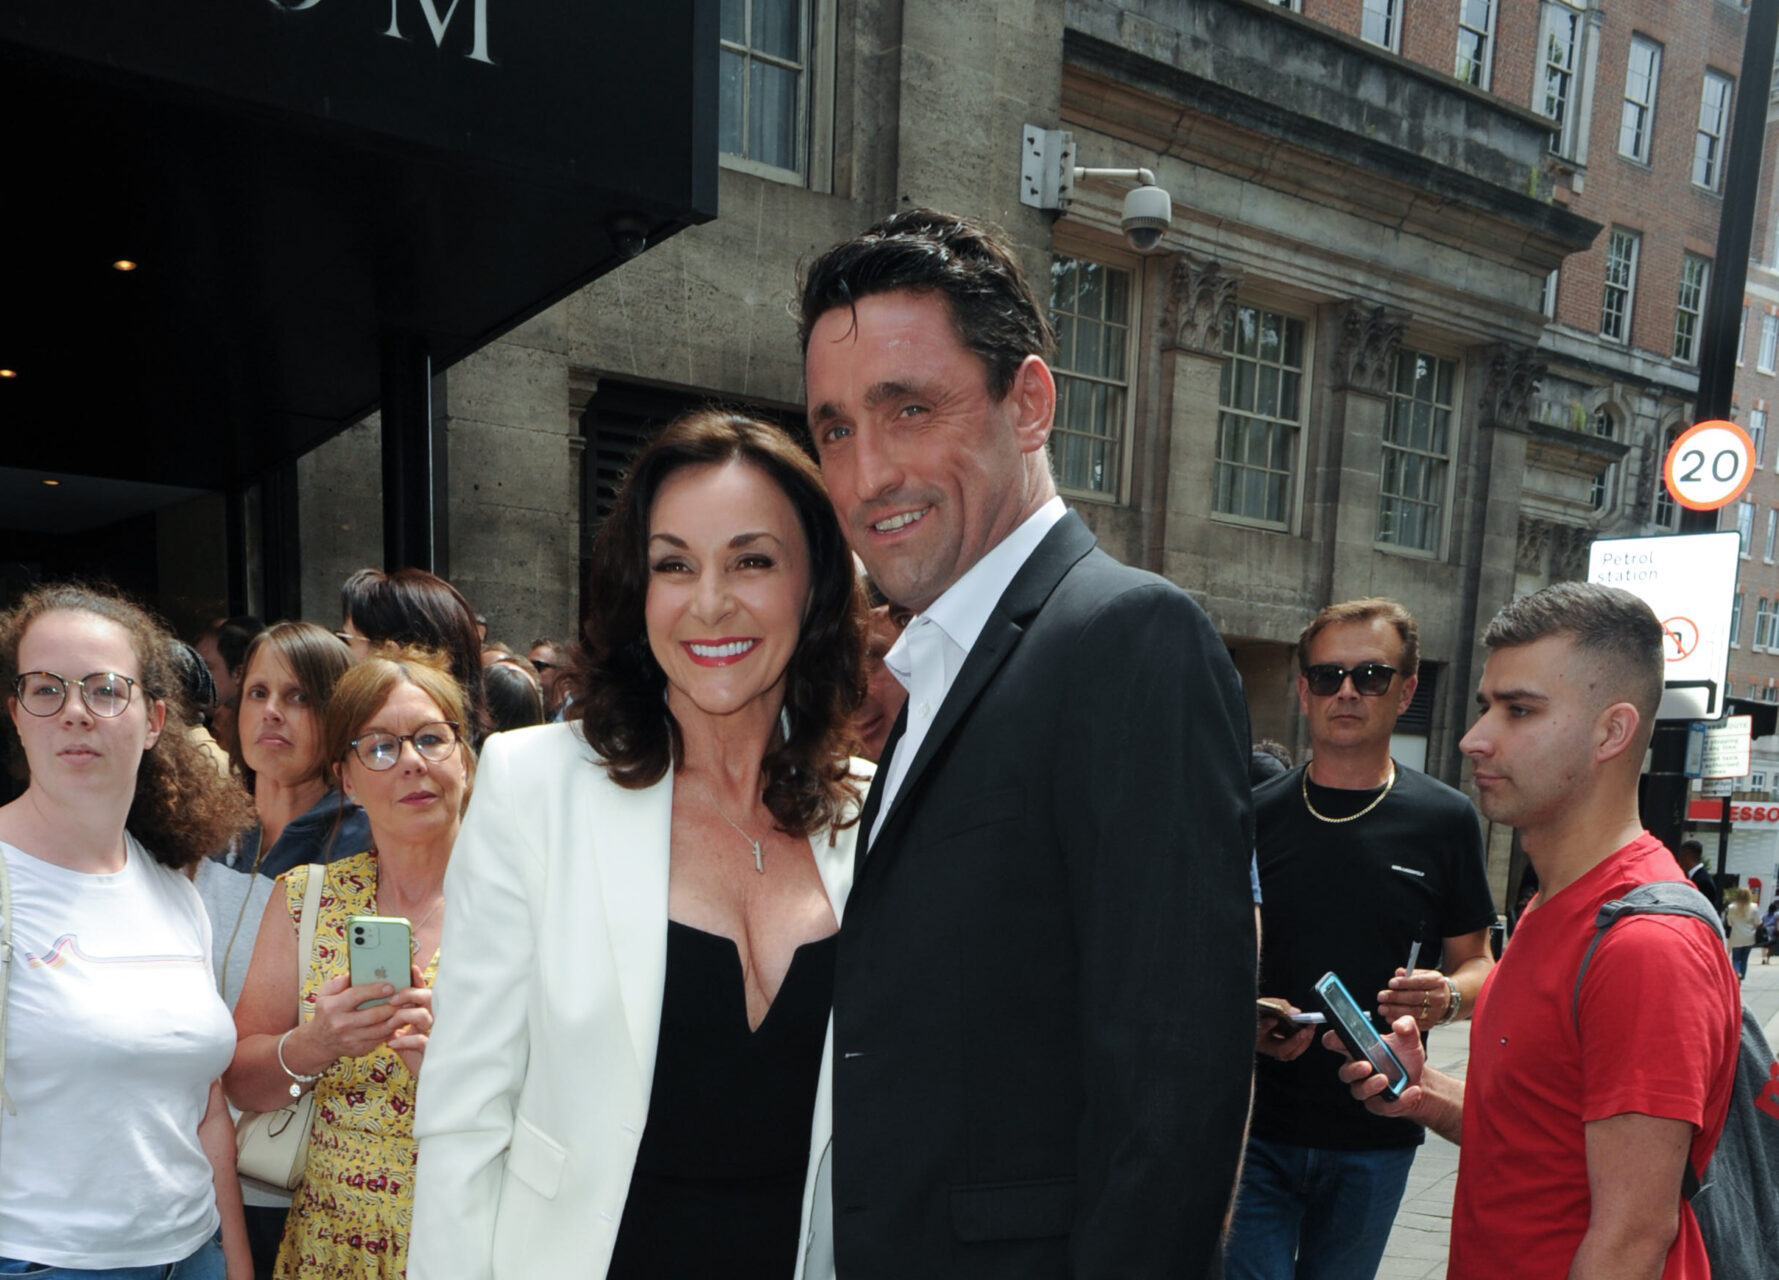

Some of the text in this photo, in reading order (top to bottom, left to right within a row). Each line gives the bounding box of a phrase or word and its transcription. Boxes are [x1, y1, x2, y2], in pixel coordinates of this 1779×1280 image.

[1680, 449, 1739, 482] 20
[1602, 551, 1654, 566] Petrol
[1596, 567, 1659, 583] station
[1730, 806, 1779, 823] ESSO
